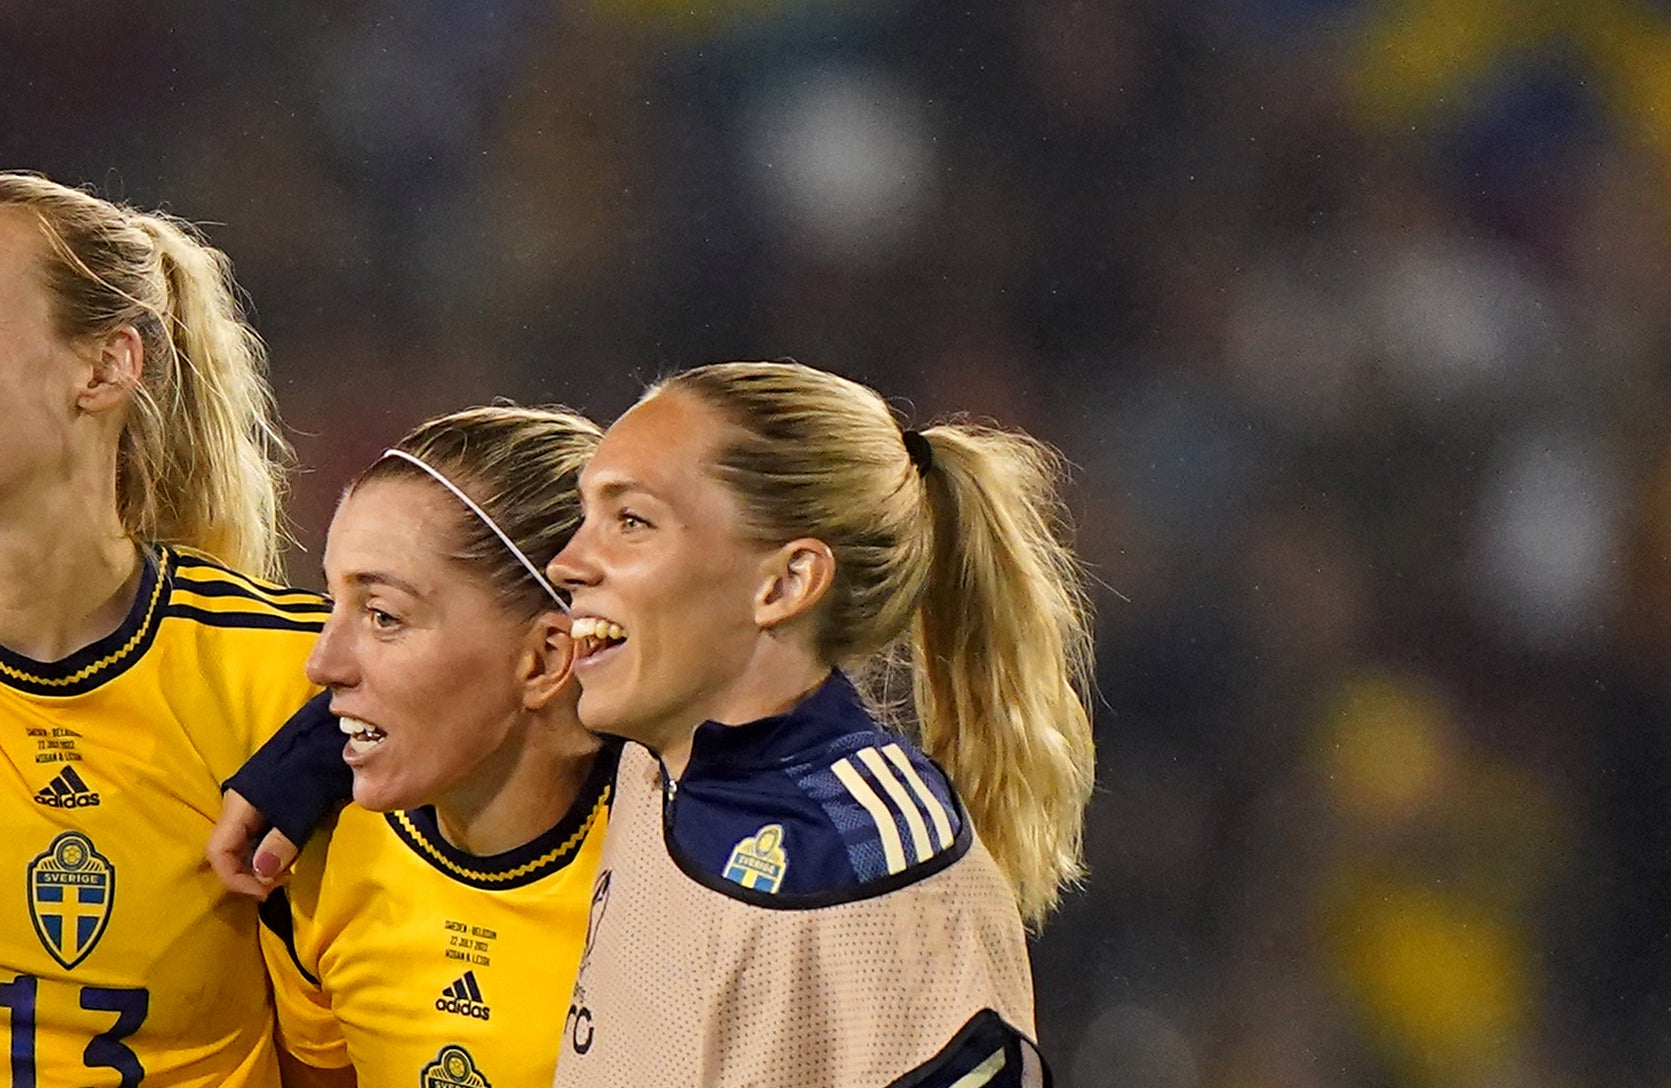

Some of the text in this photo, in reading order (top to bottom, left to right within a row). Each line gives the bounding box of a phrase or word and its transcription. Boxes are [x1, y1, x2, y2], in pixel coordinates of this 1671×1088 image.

[33, 792, 100, 809] adidas
[44, 873, 99, 884] SVERIGE
[435, 998, 490, 1021] adidas
